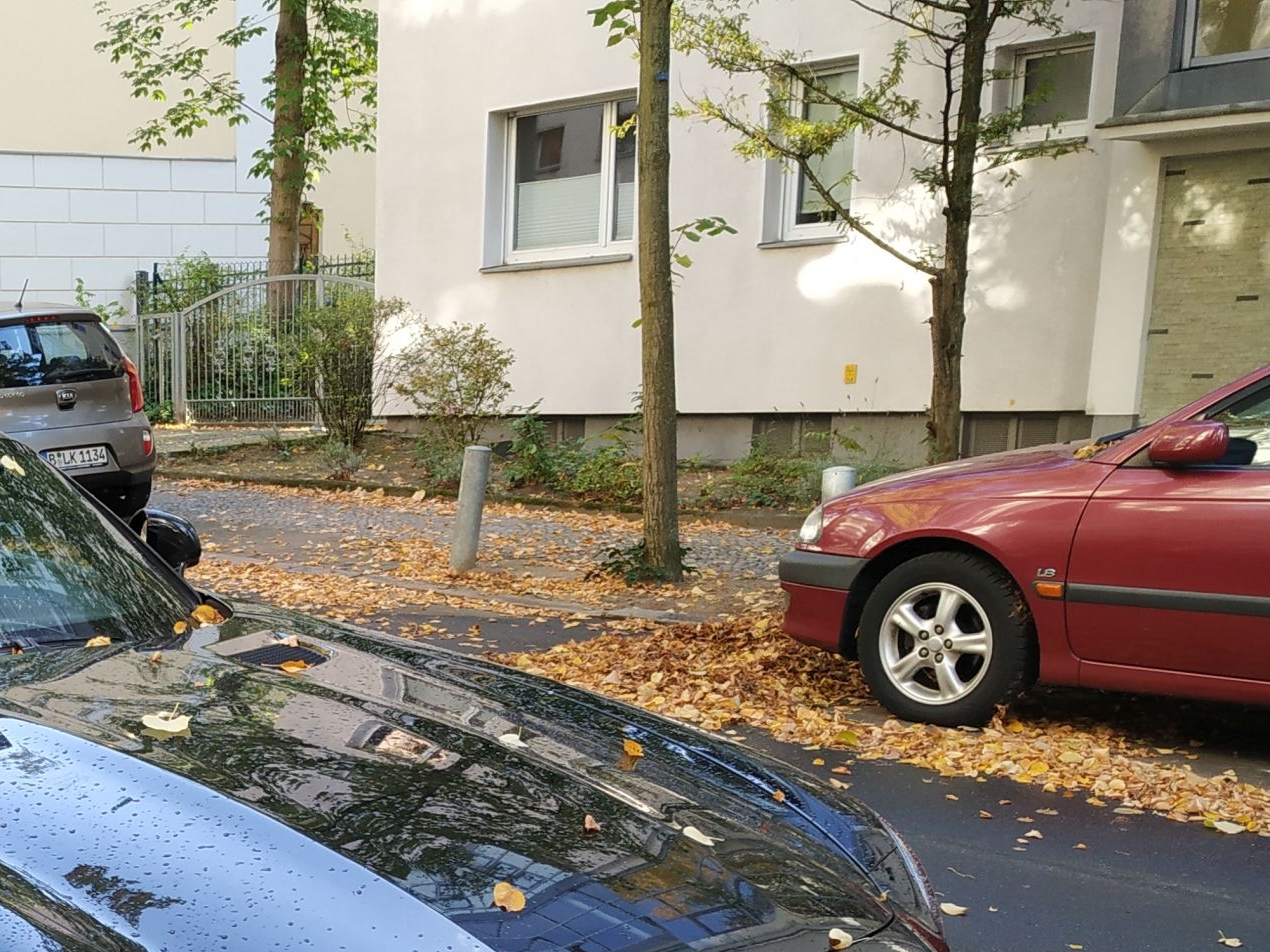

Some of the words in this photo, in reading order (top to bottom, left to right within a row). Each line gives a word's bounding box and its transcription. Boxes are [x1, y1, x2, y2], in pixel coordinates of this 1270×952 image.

[60, 391, 75, 400] KIA
[48, 453, 56, 466] B
[63, 451, 76, 465] LK
[79, 448, 106, 463] 1134
